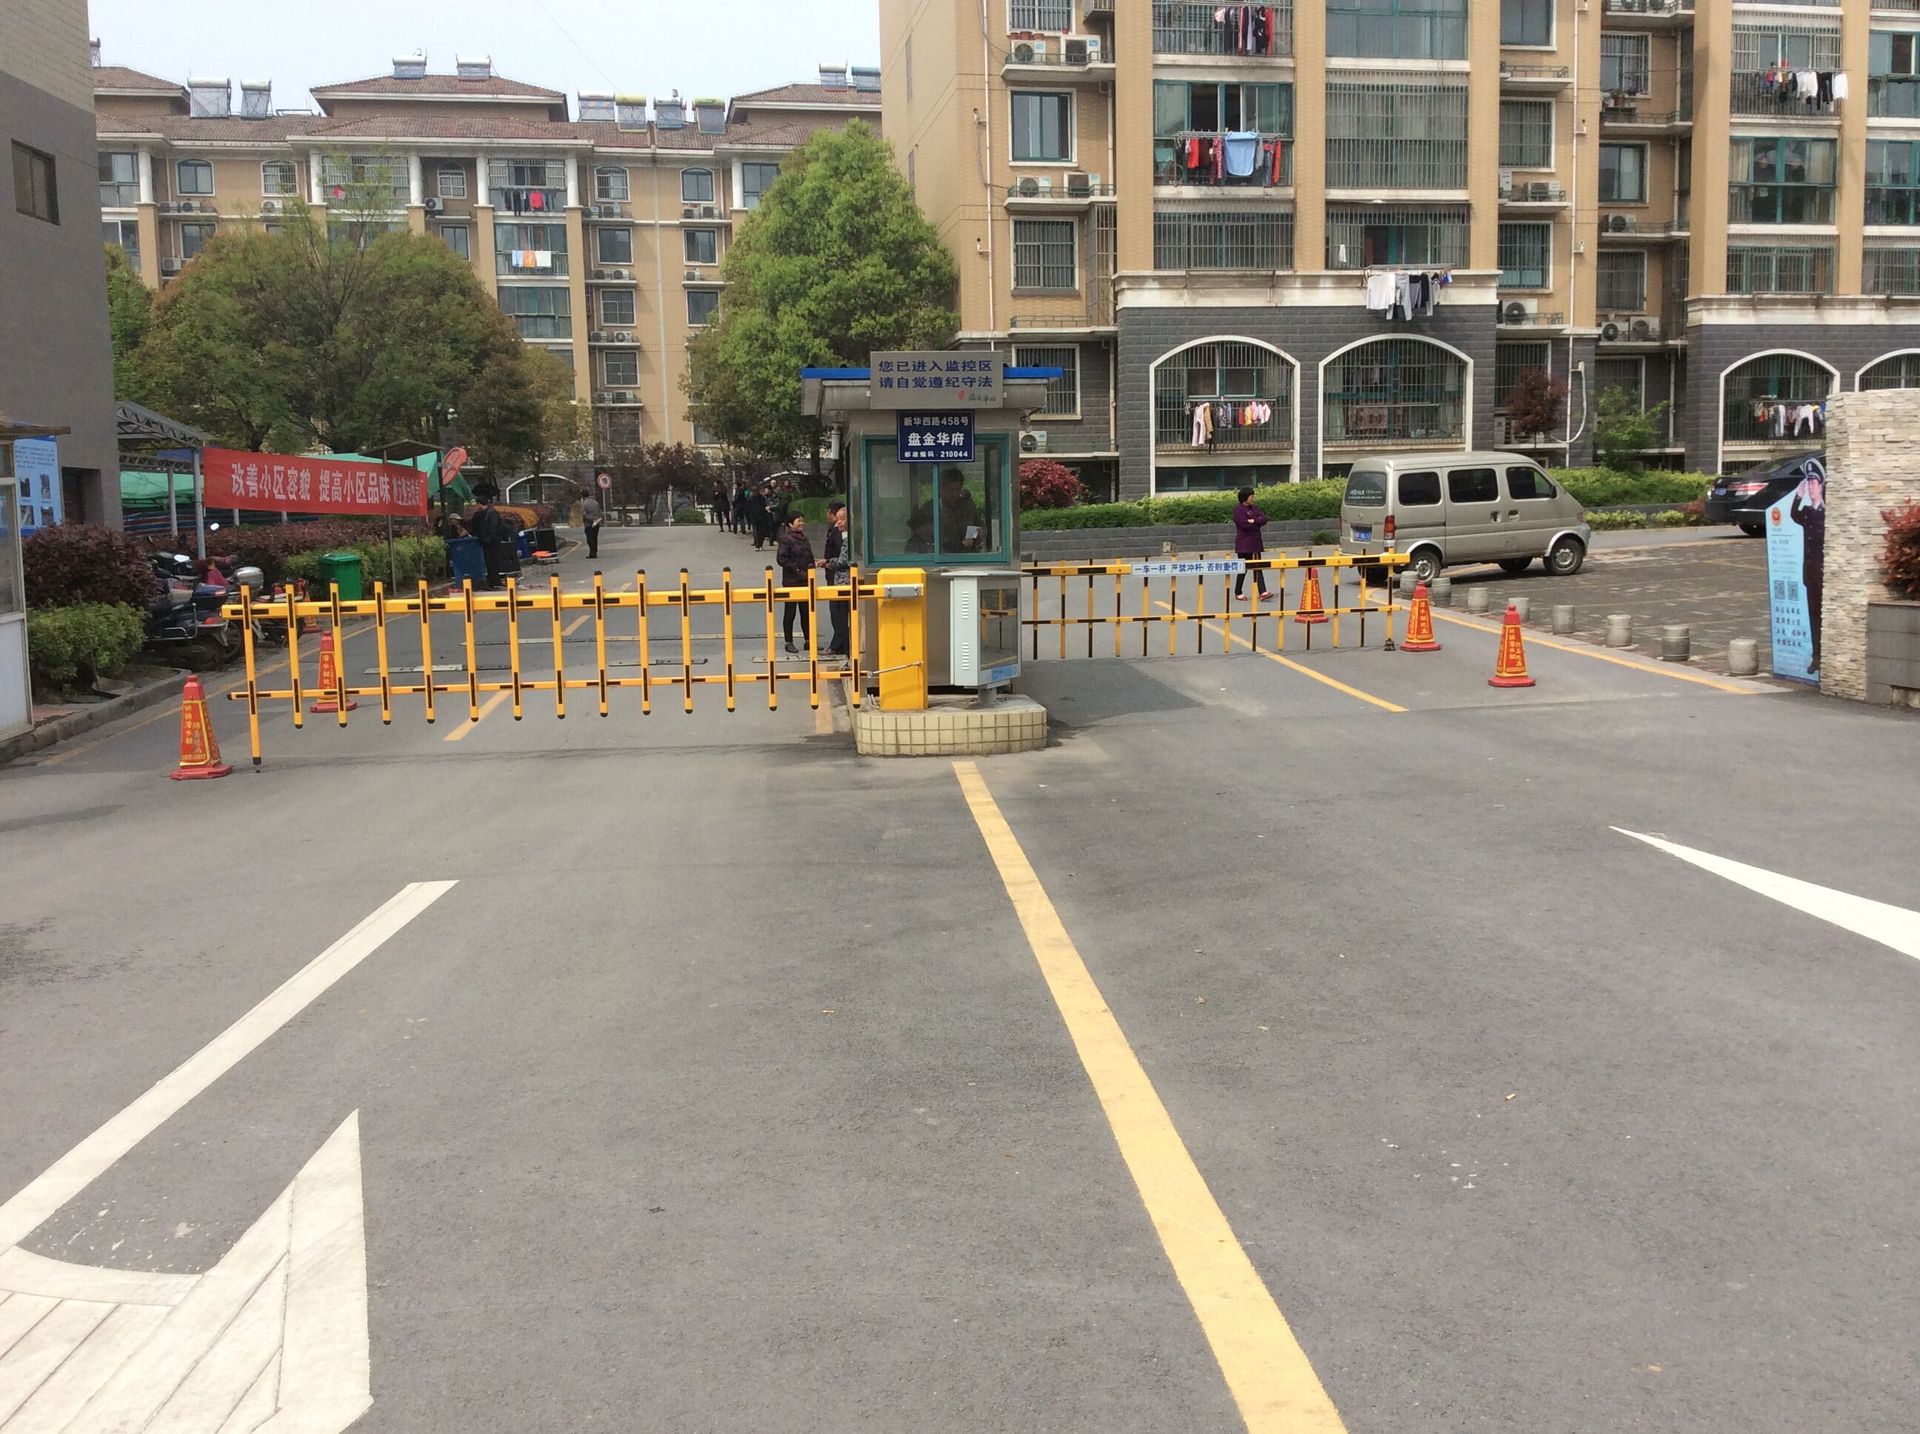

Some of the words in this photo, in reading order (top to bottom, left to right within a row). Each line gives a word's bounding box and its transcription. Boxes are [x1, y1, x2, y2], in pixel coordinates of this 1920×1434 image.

[879, 360, 993, 372] 您已进入监控区
[879, 376, 993, 389] 请自觉遵纪守法
[903, 416, 969, 426] 新华西路458号
[907, 432, 965, 446] 盘金华府
[231, 462, 311, 501] 改善小区容貌
[319, 469, 391, 505] 提高小区品味
[1134, 564, 1167, 574] 一车一杆
[1171, 563, 1204, 573] 严禁冲杆
